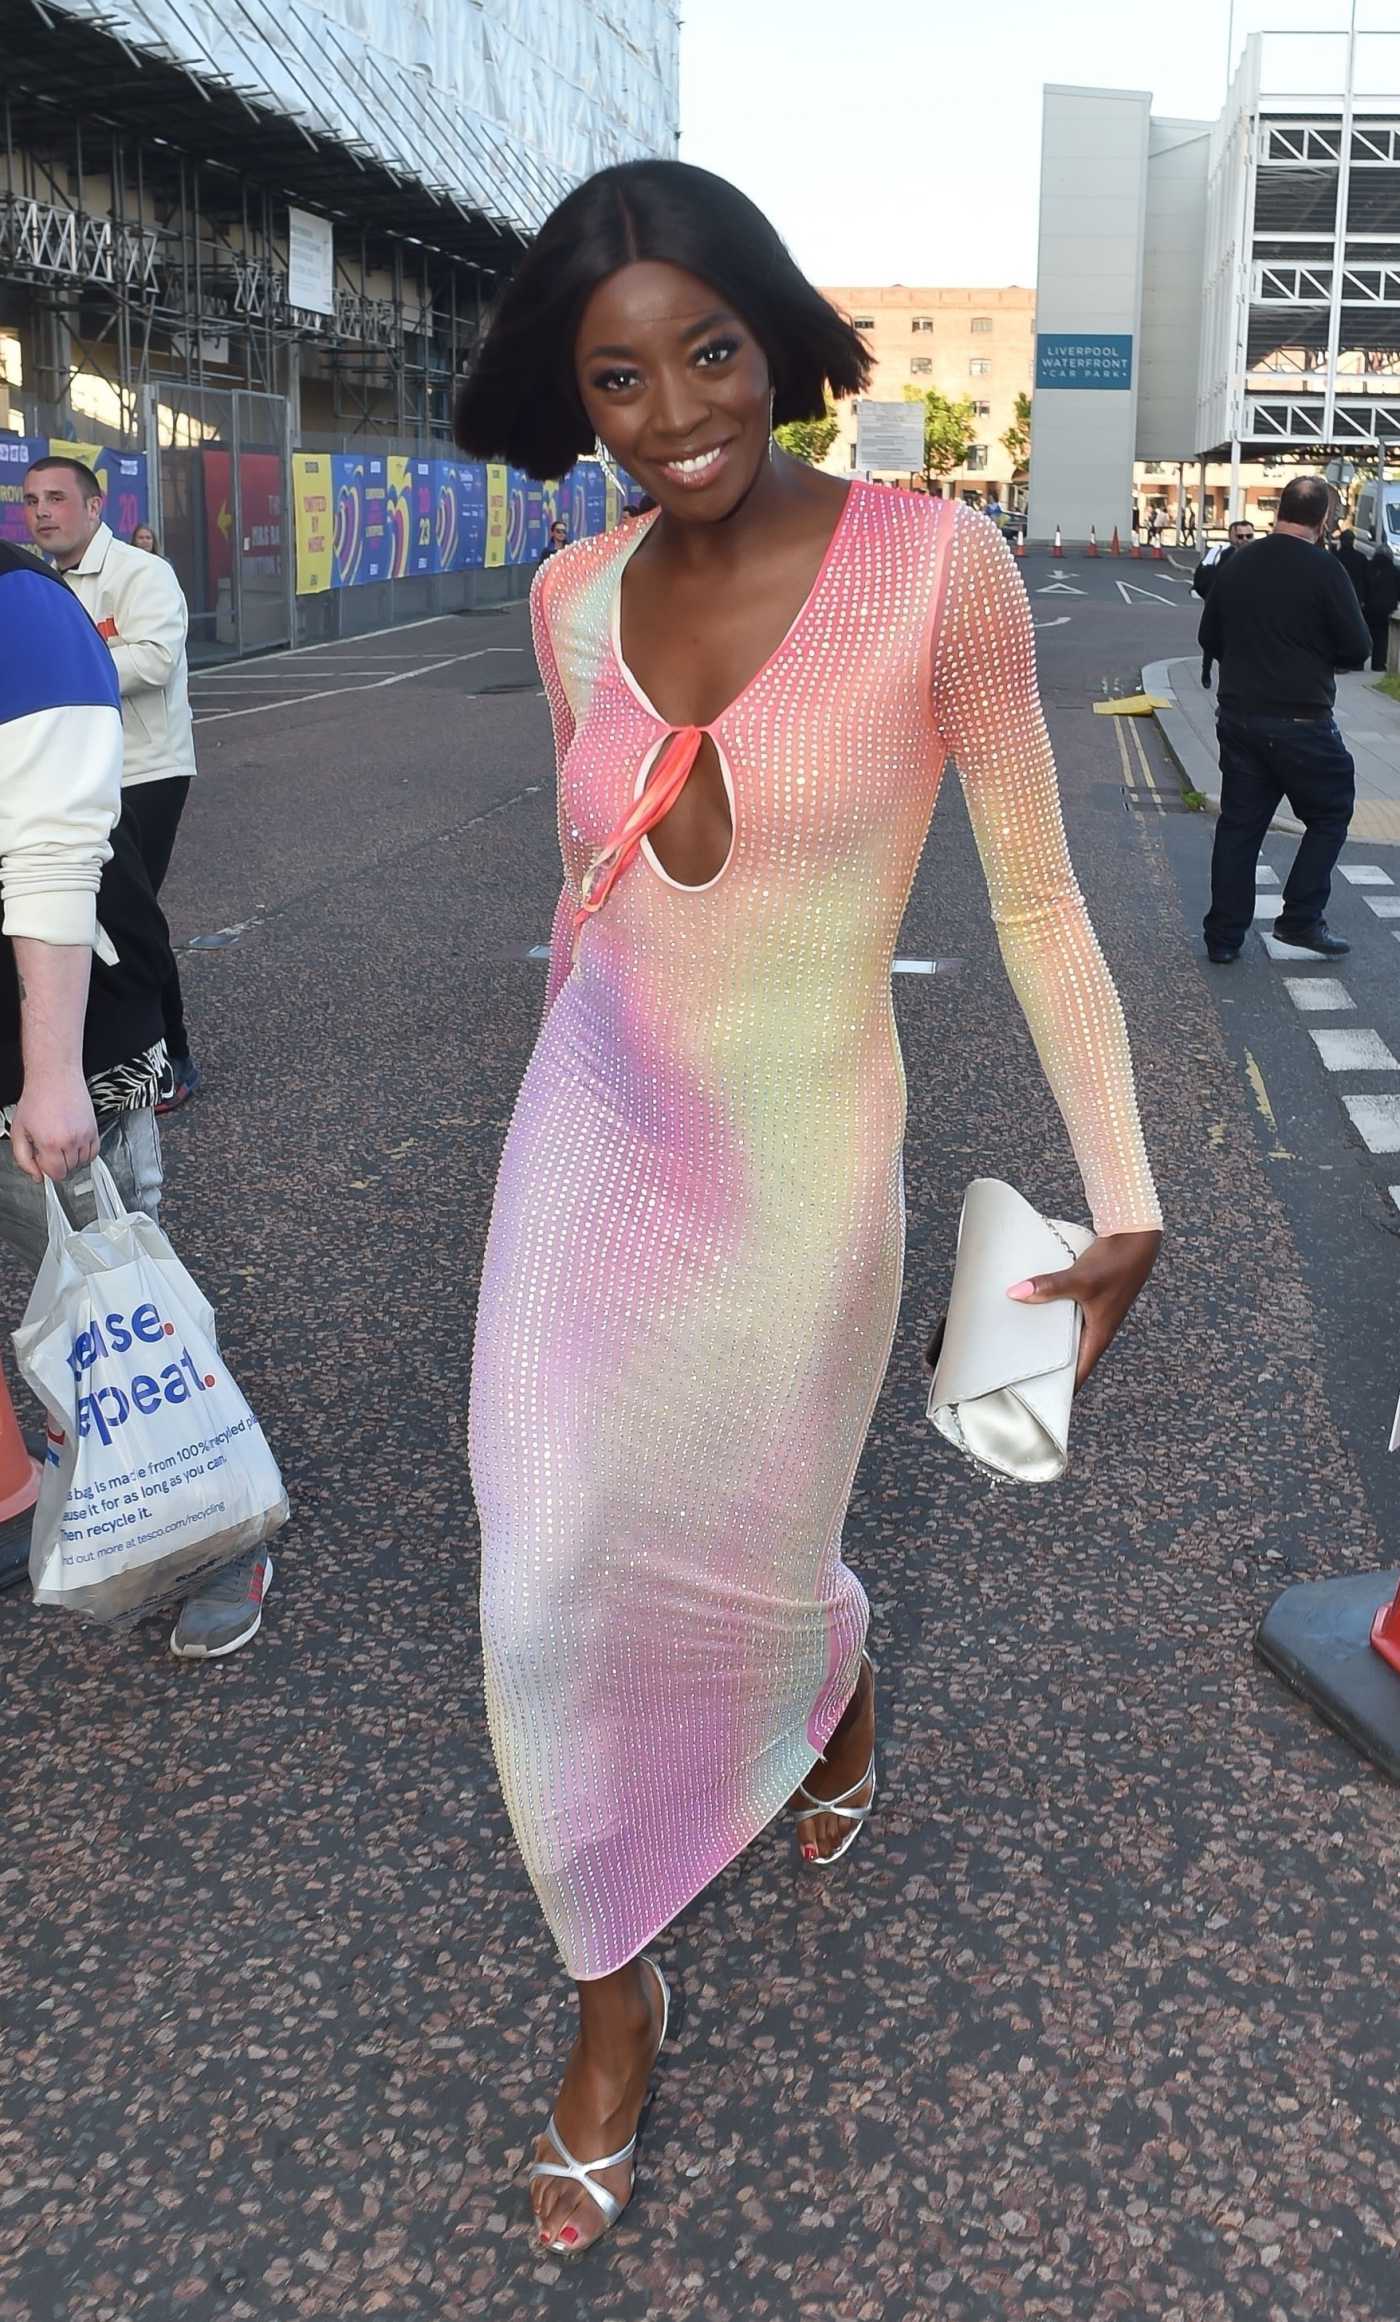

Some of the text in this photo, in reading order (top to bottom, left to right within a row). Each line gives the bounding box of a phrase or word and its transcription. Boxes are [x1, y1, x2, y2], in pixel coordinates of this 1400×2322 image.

[1047, 346, 1119, 356] LIVERPOOL
[1042, 359, 1128, 368] WATERFRONT
[1050, 369, 1120, 377] CAR PARK
[419, 518, 431, 545] 23
[94, 1481, 107, 1493] is
[147, 1456, 177, 1475] from
[176, 1440, 210, 1462] 100%
[88, 1504, 99, 1516] it
[101, 1498, 120, 1511] for
[123, 1492, 139, 1504] as
[141, 1480, 170, 1498] long
[169, 1474, 183, 1487] as
[183, 1464, 205, 1484] you
[87, 1513, 136, 1533] recycle
[137, 1506, 152, 1520] it.
[76, 1551, 95, 1563] out
[97, 1543, 124, 1557] more
